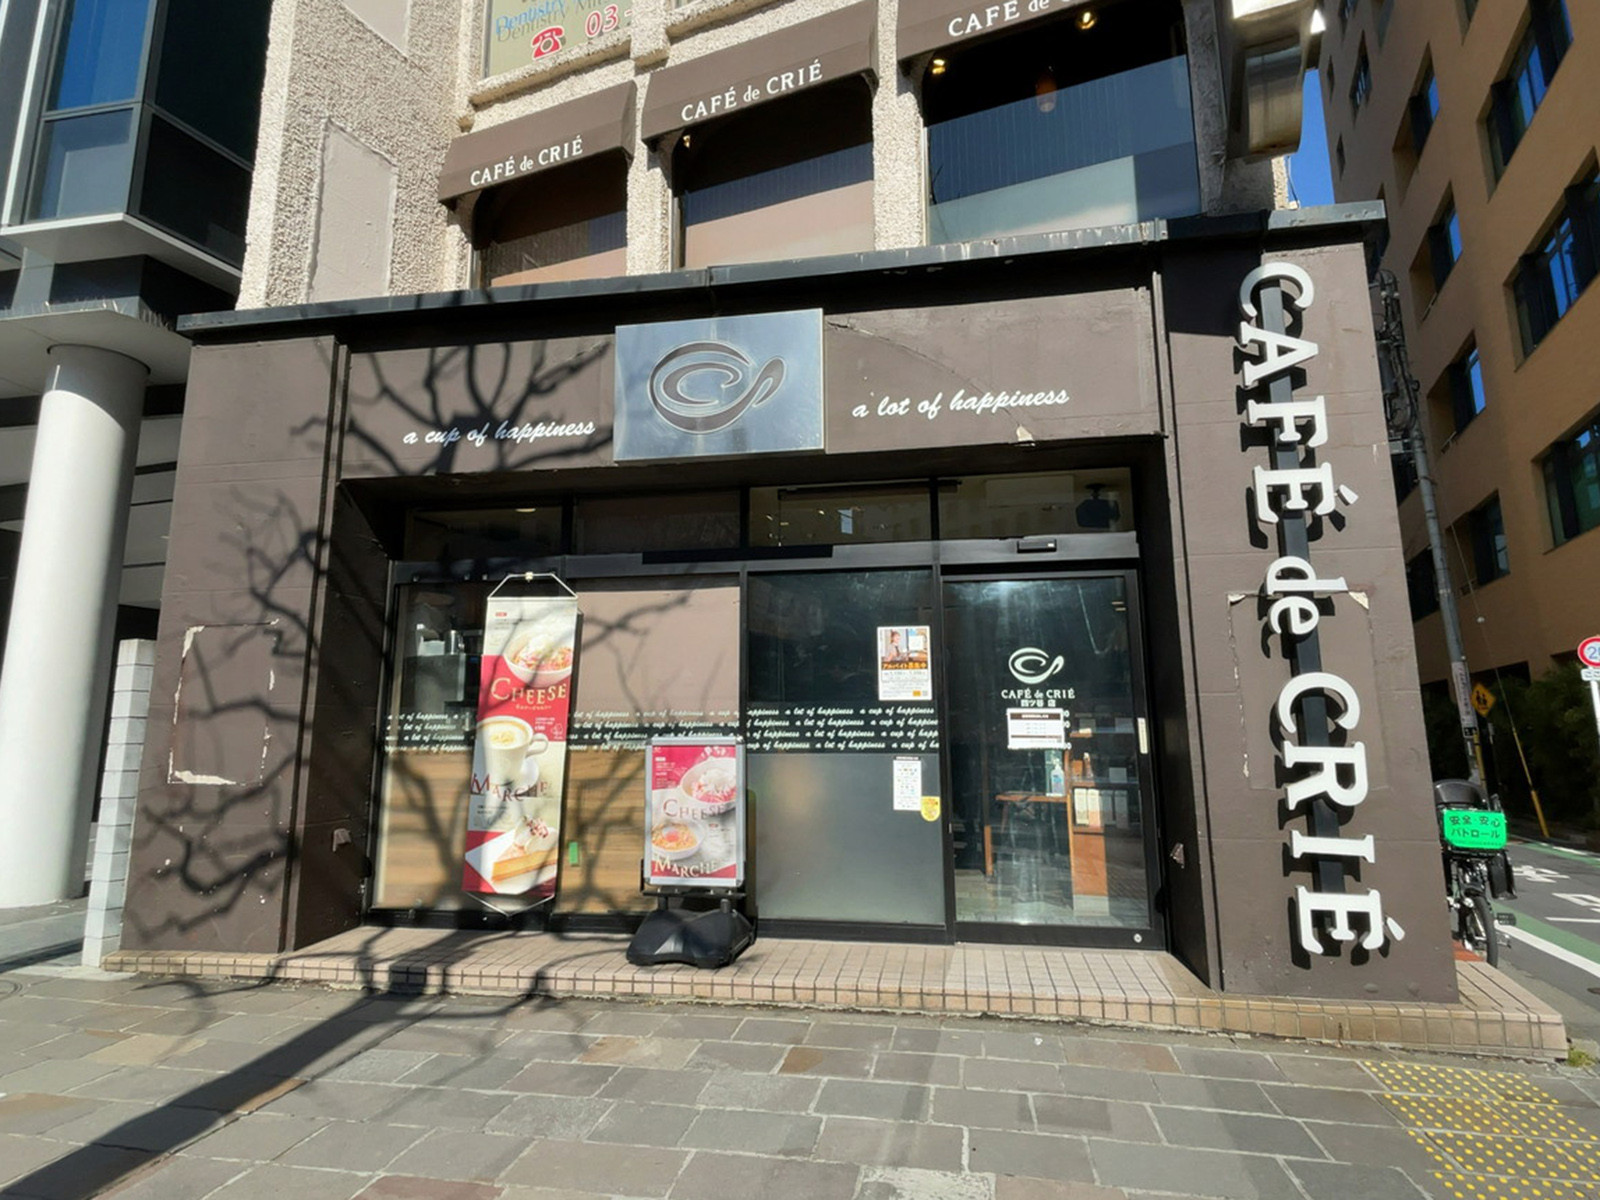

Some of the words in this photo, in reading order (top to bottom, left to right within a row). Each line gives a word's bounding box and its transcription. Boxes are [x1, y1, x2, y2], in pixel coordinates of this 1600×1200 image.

[681, 86, 737, 121] CAFÉ
[743, 85, 760, 102] de
[766, 58, 823, 95] CRIÉ
[470, 156, 516, 186] CAFÉ
[519, 155, 534, 172] de
[538, 134, 584, 167] CRIÉ
[852, 403, 869, 418] a
[877, 396, 910, 416] lot
[917, 392, 943, 420] of
[949, 389, 1070, 415] happiness
[1239, 261, 1359, 525] CAFÉ
[403, 431, 419, 444] a
[425, 427, 462, 447] cup
[466, 423, 490, 447] of
[494, 420, 596, 443] happiness
[1265, 555, 1349, 635] de
[1587, 646, 1600, 660] 2
[1001, 687, 1032, 699] CAFÉ
[1046, 687, 1076, 699] CRIÉ
[1277, 671, 1406, 956] CRIÉ
